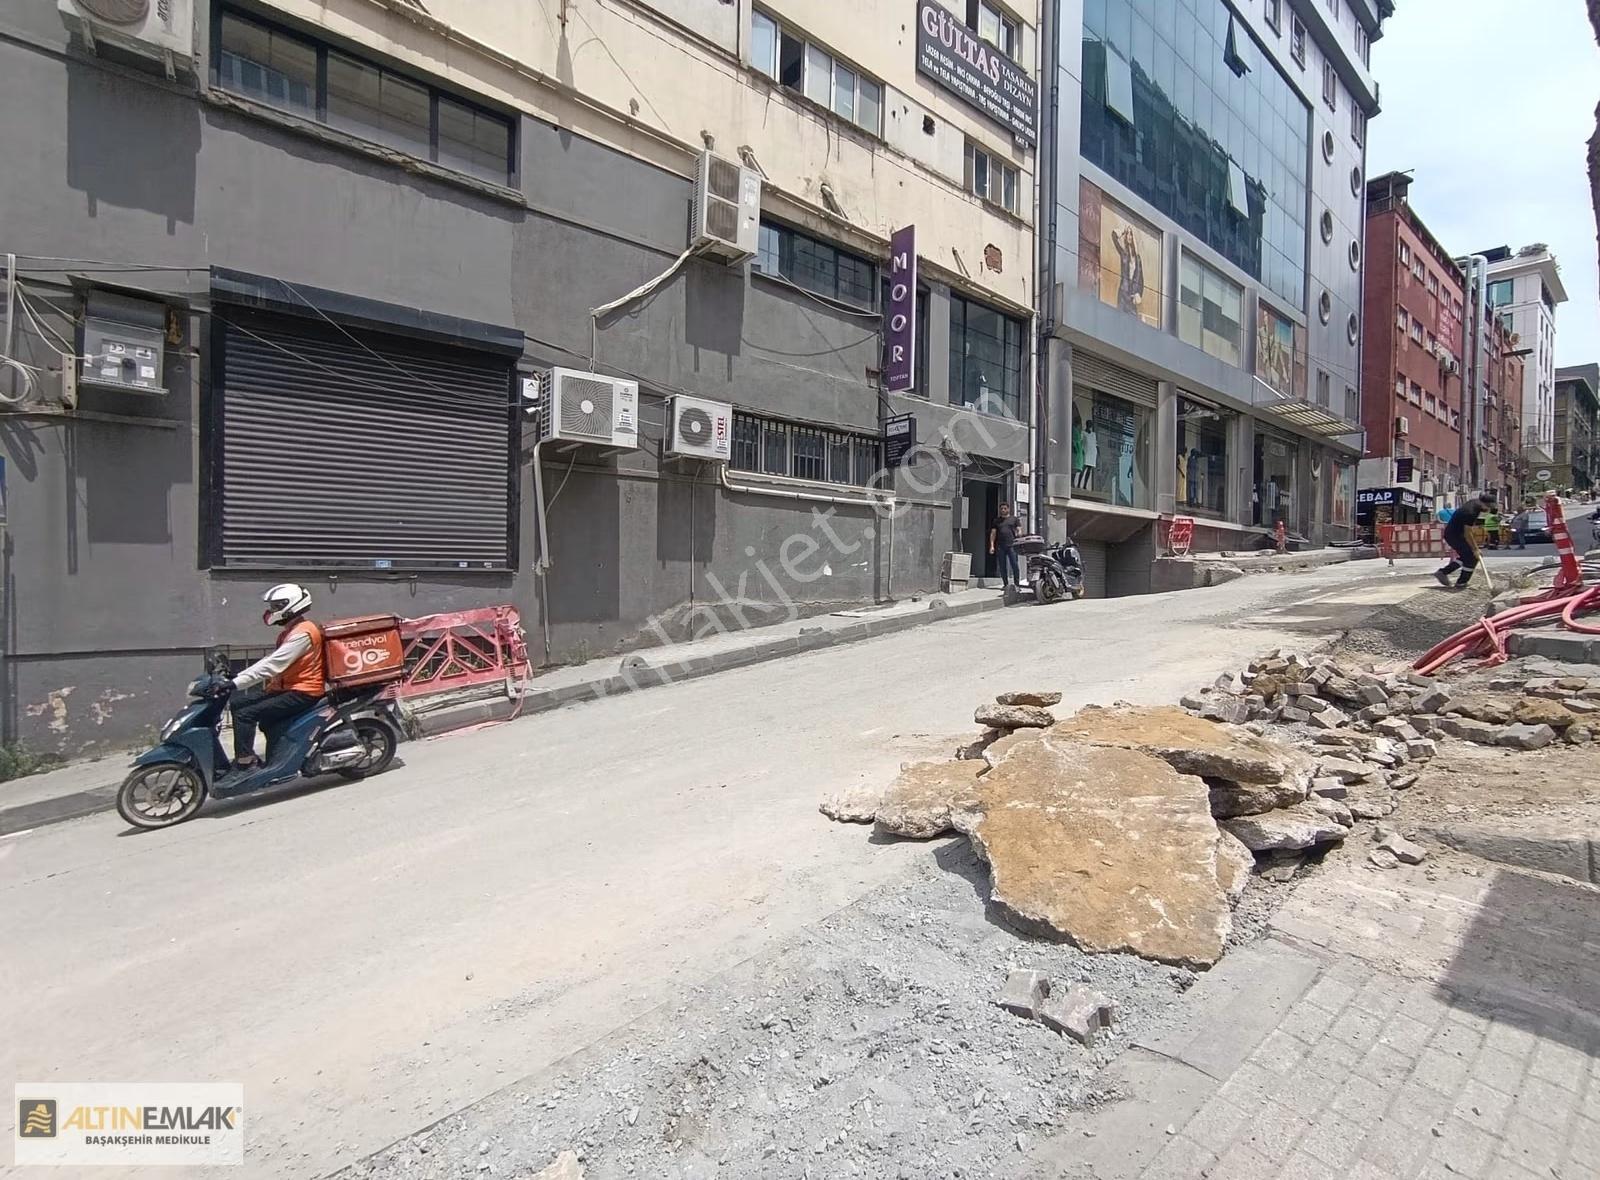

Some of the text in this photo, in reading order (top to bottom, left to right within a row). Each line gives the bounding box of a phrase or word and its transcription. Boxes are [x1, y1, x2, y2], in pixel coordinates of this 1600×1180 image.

[922, 6, 1000, 86] GÜLTAŞ
[1001, 64, 1034, 96] TASARIM
[1004, 80, 1032, 107] DİZAYN
[891, 252, 908, 363] MOOR
[1357, 491, 1393, 503] EBAP
[342, 634, 387, 649] trendyol
[344, 648, 389, 674] go
